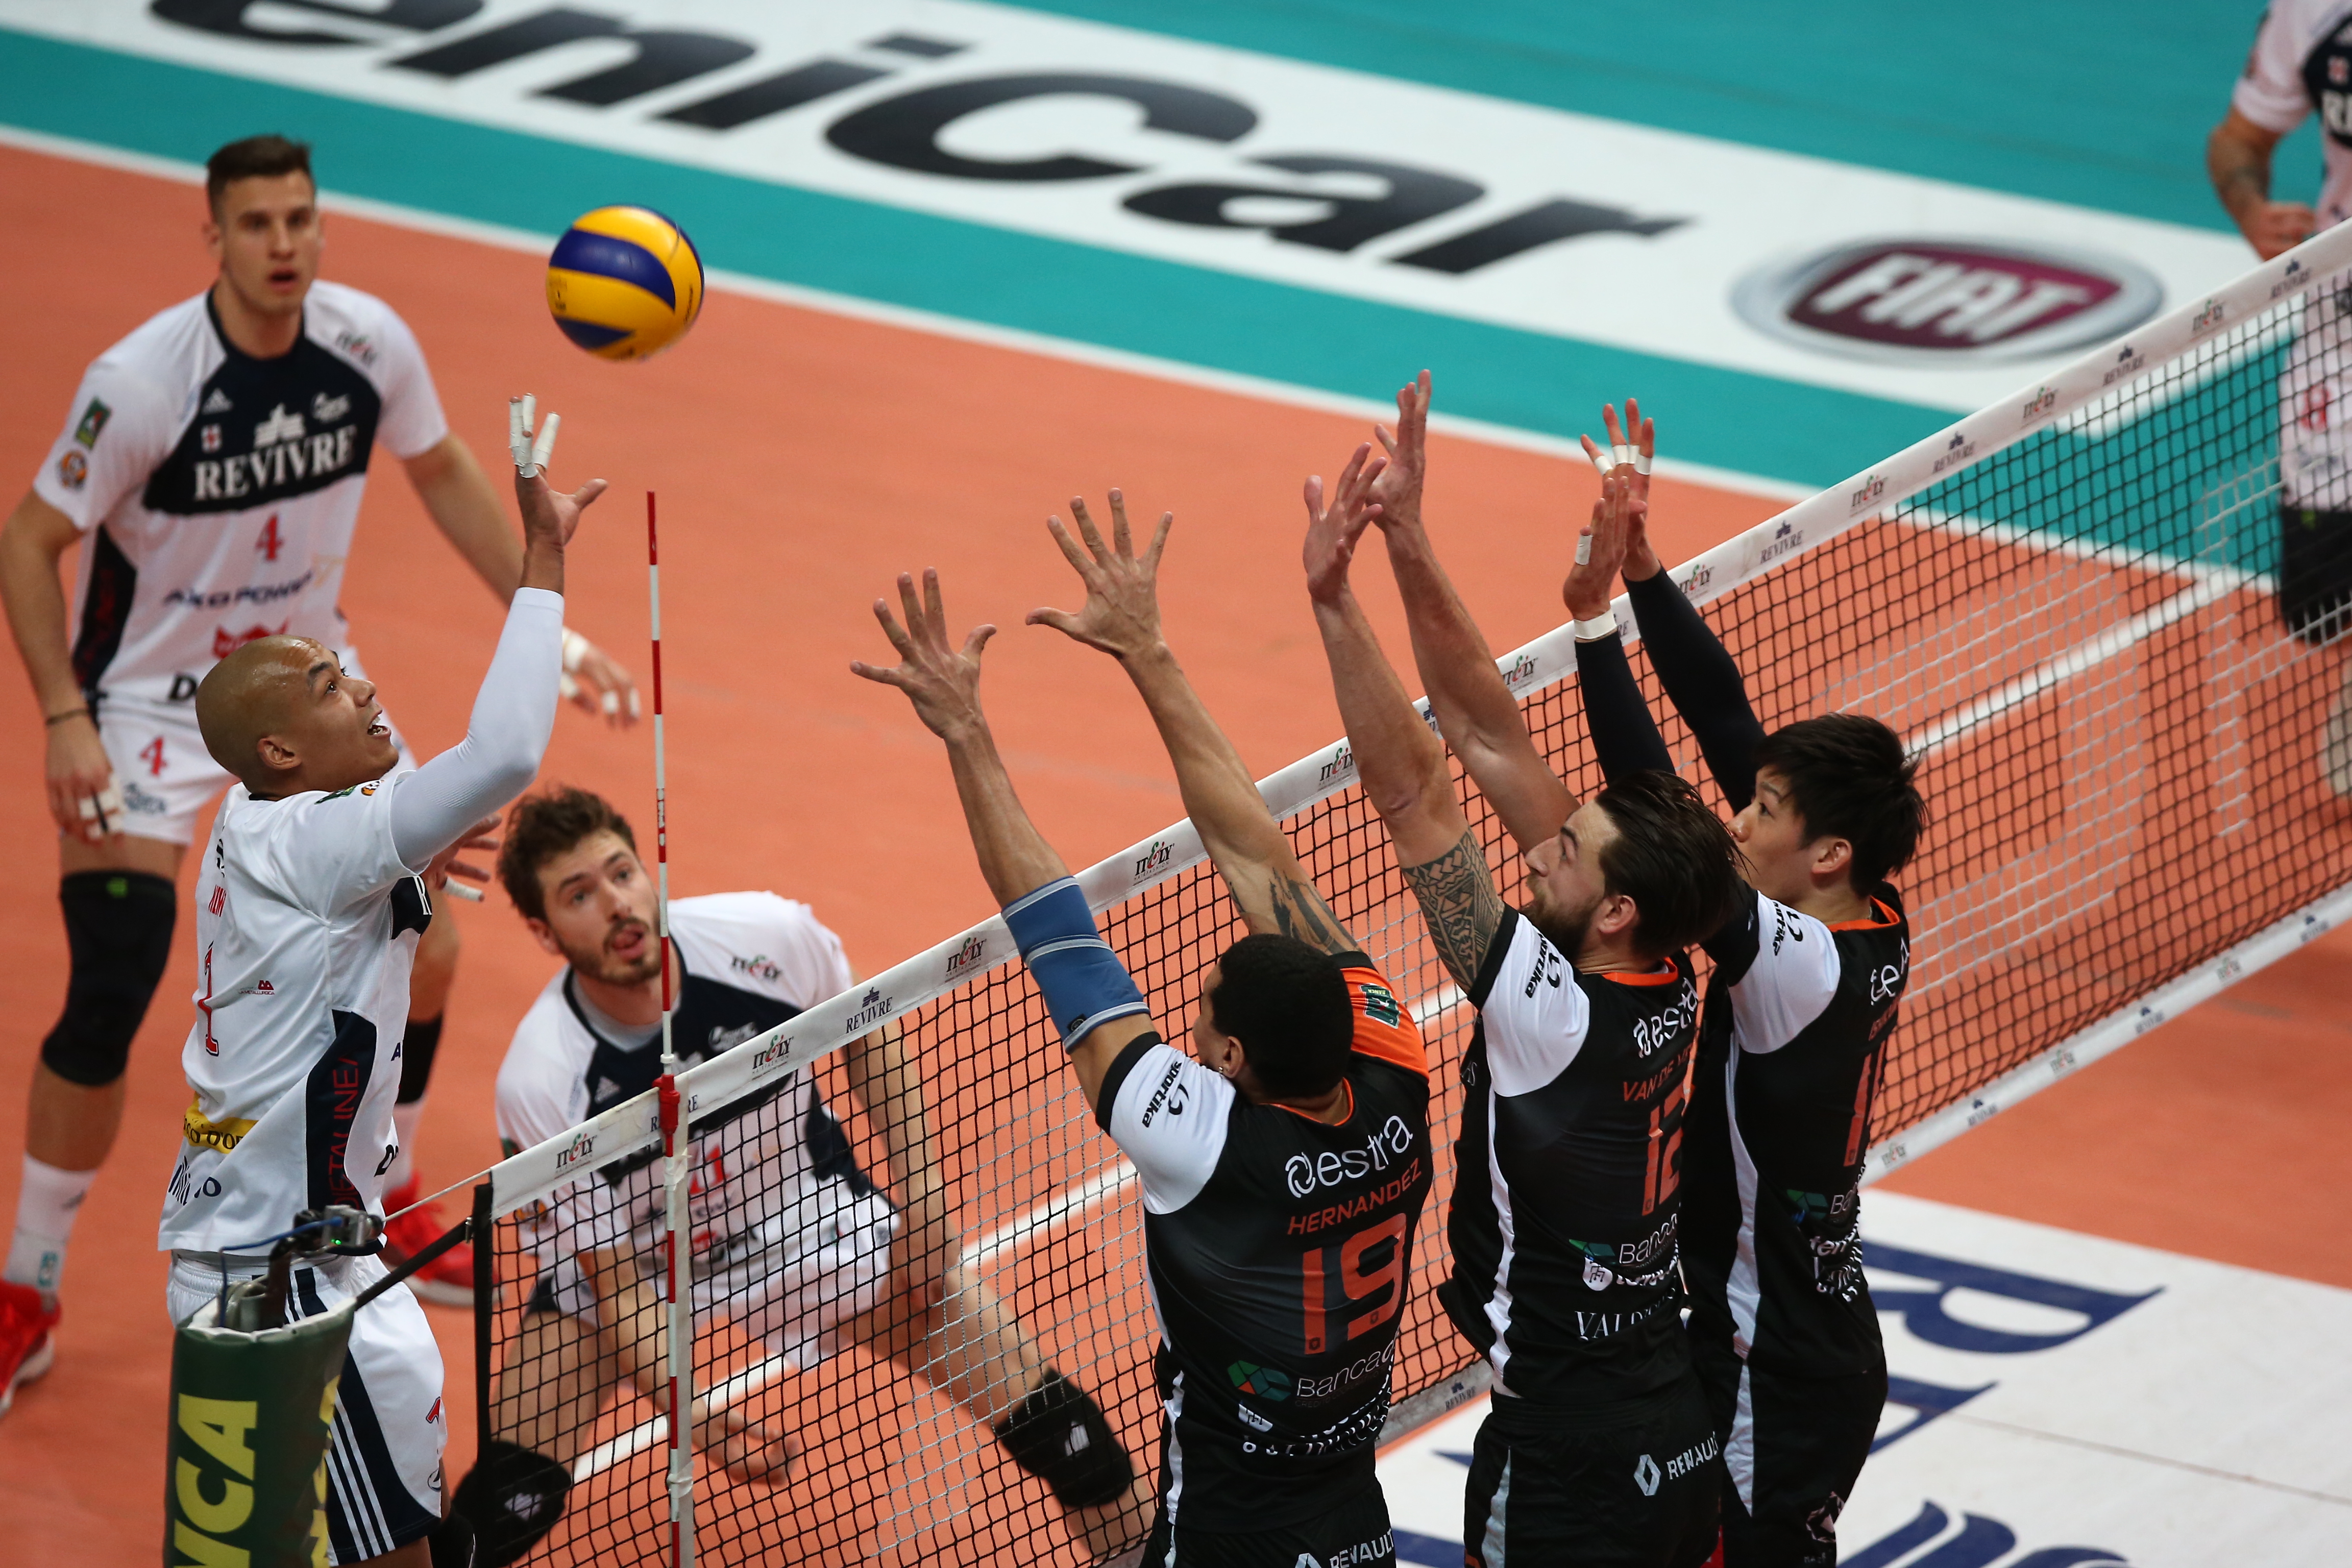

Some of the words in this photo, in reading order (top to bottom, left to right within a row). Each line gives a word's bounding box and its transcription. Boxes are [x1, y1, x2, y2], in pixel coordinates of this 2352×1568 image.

[1812, 251, 2092, 345] FIAT
[195, 425, 357, 501] REVIVRE
[256, 512, 284, 562] 4
[139, 735, 168, 777] 4
[846, 996, 892, 1034] REVIVRE
[1287, 1157, 1422, 1235] HERNANDEZ
[1302, 1212, 1407, 1355] 19
[1329, 1528, 1394, 1568] RENAULT
